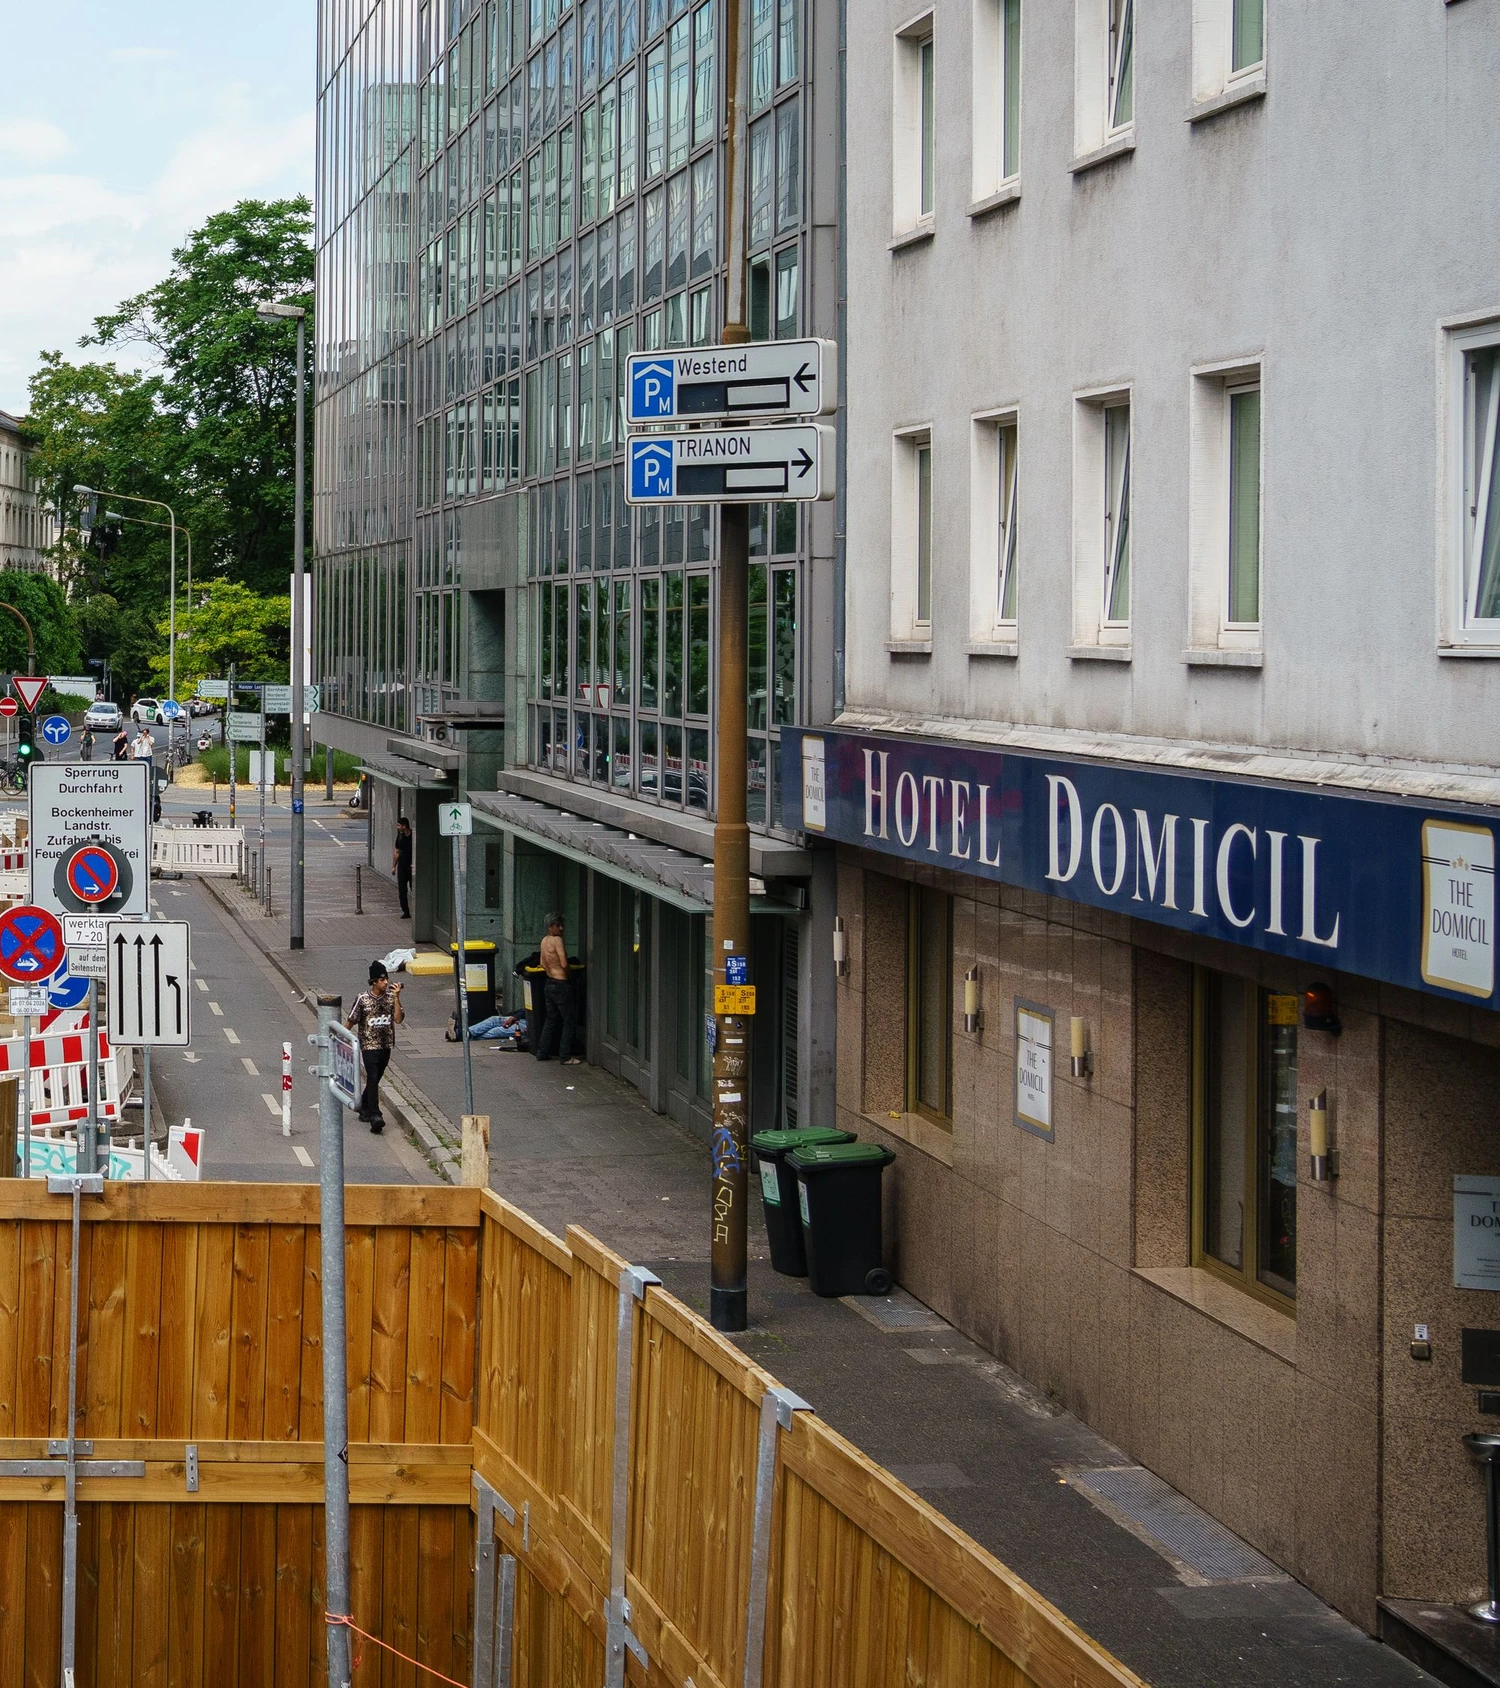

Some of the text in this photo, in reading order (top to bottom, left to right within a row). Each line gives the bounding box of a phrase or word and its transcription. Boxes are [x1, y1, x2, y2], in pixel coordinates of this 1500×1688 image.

[678, 354, 748, 376] Westend
[644, 378, 661, 408] P
[658, 396, 670, 414] M
[676, 436, 751, 458] TRIANON
[644, 458, 660, 488] P
[658, 477, 670, 494] M
[428, 727, 446, 741] 16
[64, 768, 119, 780] Sperrung
[811, 766, 820, 782] THE
[59, 783, 123, 793] Durchfahrt
[806, 784, 824, 802] DOMICIL
[52, 807, 134, 817] Bockenheimer
[64, 820, 112, 830] Landstr.
[105, 834, 122, 844] bis
[861, 747, 1341, 949] HOTEL DOMICIL
[1448, 879, 1474, 908] THE
[1432, 908, 1489, 945] DOMICIL
[92, 954, 106, 962] dem
[1452, 948, 1468, 960] HOTEL
[1026, 1050, 1037, 1070] THE
[1019, 1067, 1045, 1094] DOMICIL
